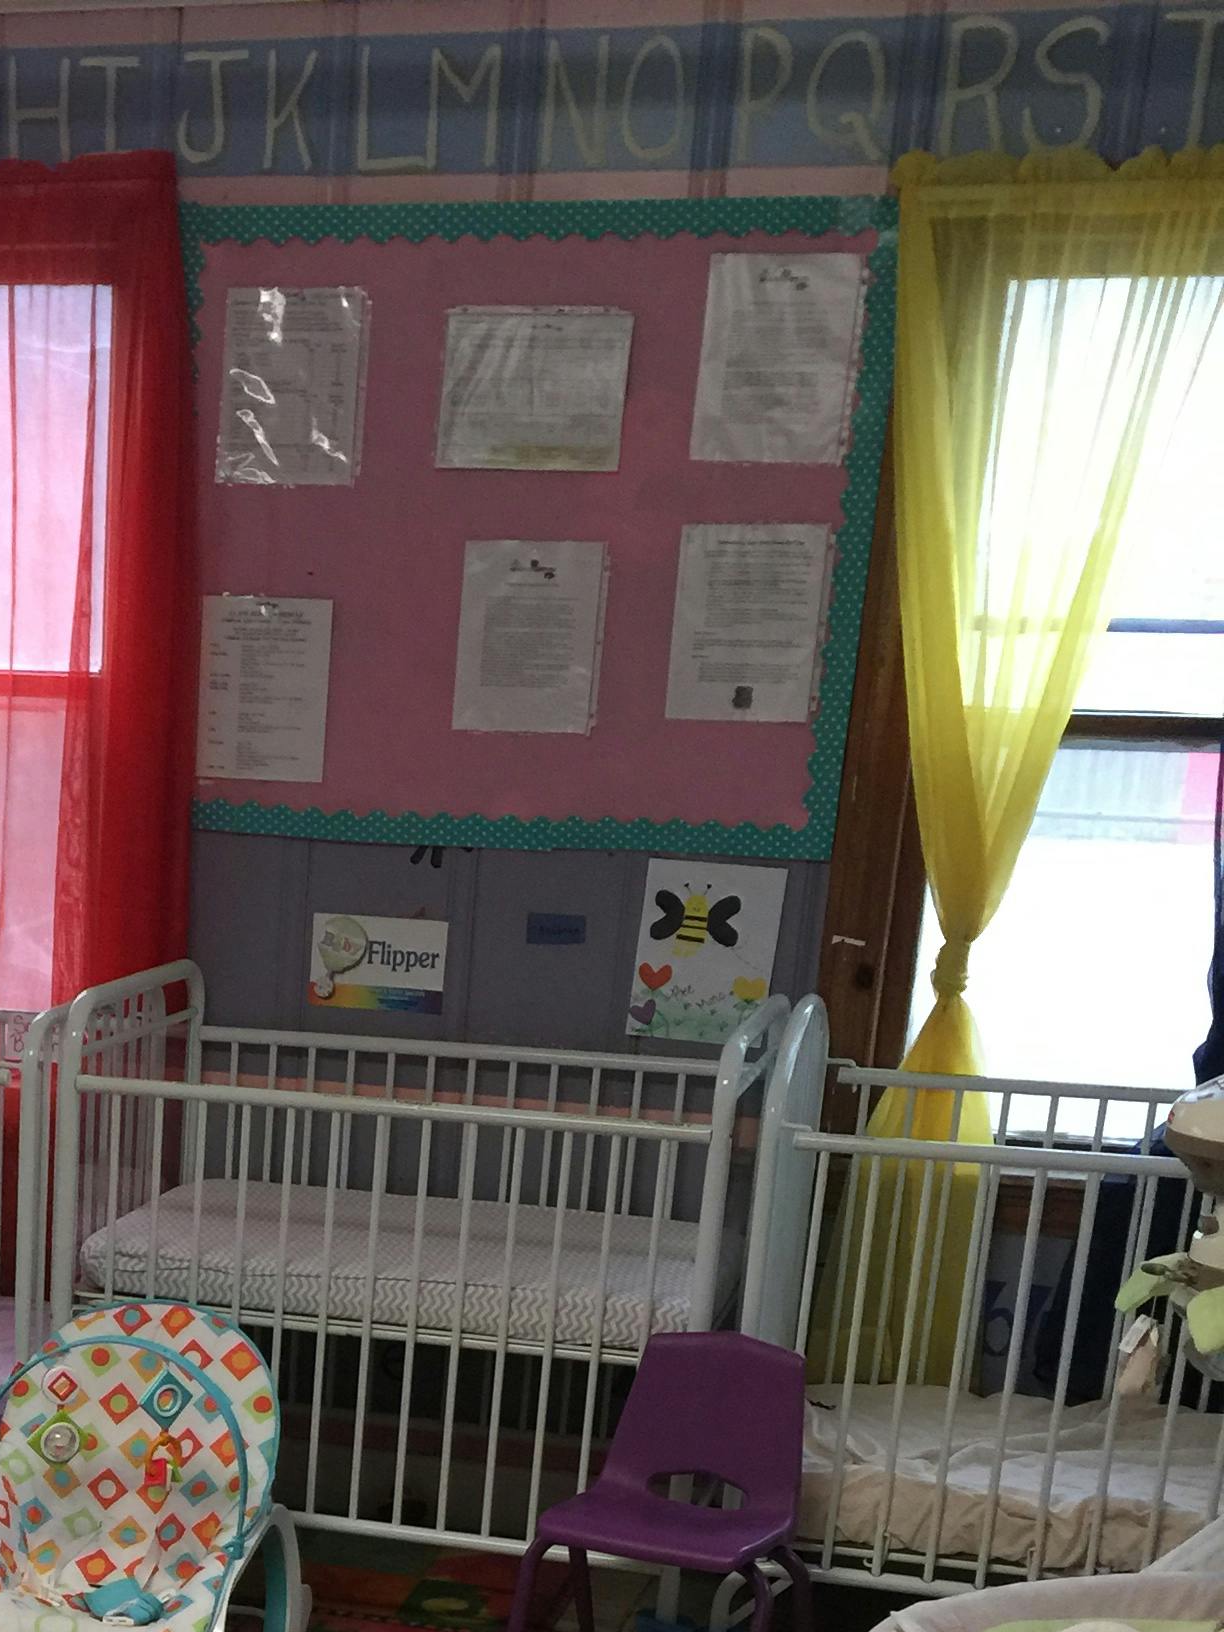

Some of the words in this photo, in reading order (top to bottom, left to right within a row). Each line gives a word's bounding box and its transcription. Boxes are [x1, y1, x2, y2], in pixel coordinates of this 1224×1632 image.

[8, 55, 72, 160] H
[178, 50, 250, 163] J
[262, 49, 320, 171] K
[356, 45, 429, 172] L
[428, 45, 504, 168] M
[538, 39, 612, 164] N
[622, 34, 686, 162] O
[737, 27, 795, 160] P
[806, 31, 887, 162] Q
[937, 22, 1020, 156] R
[1020, 16, 1112, 150] S
[367, 940, 441, 972] Flipper
